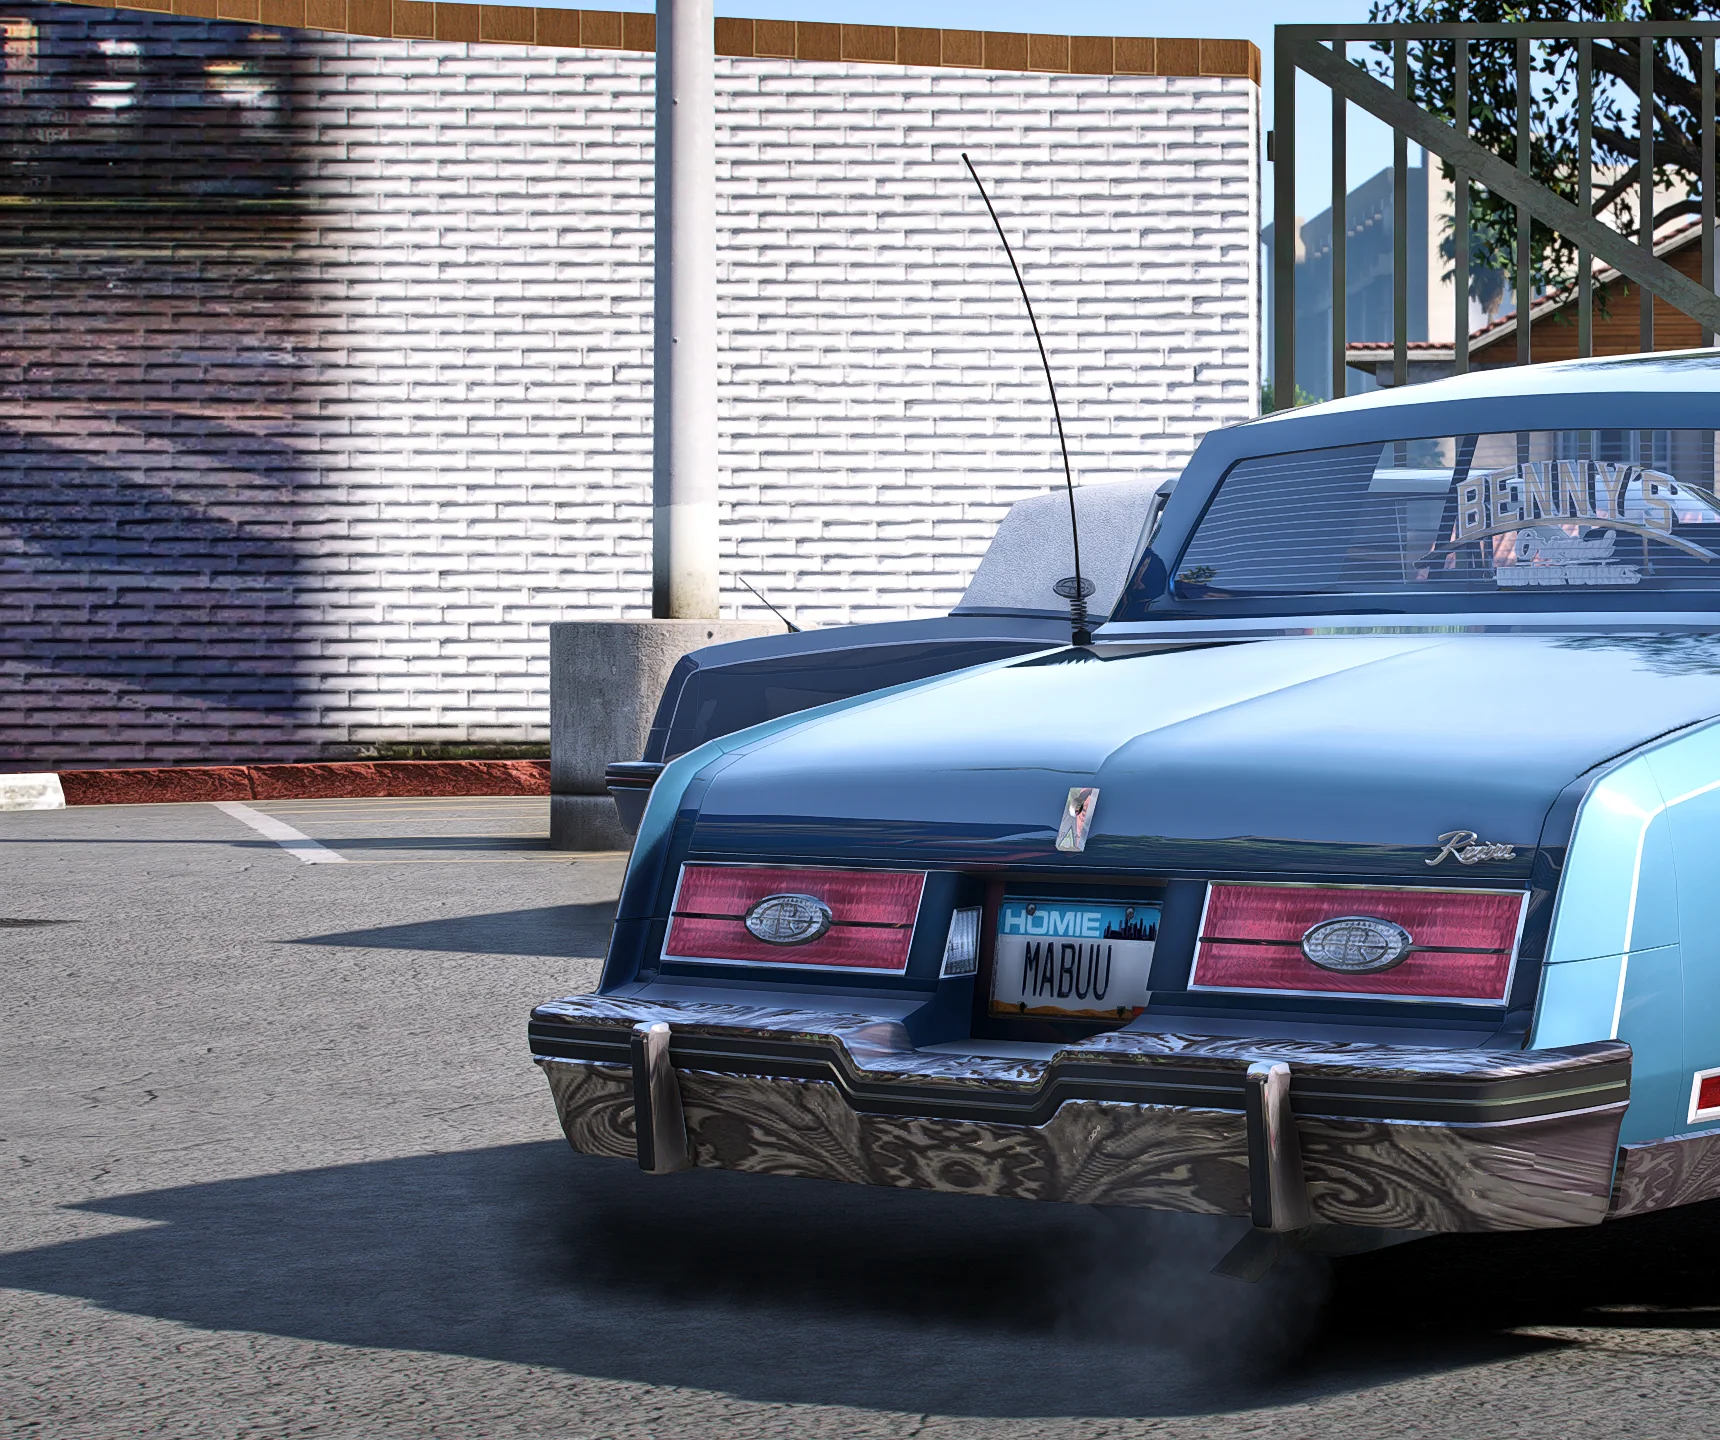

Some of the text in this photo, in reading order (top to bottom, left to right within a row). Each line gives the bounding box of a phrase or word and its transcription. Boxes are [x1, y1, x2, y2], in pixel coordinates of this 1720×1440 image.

[1457, 459, 1677, 537] BENNY'S
[1004, 908, 1102, 937] HOMIE
[1021, 940, 1113, 1001] MABUU
